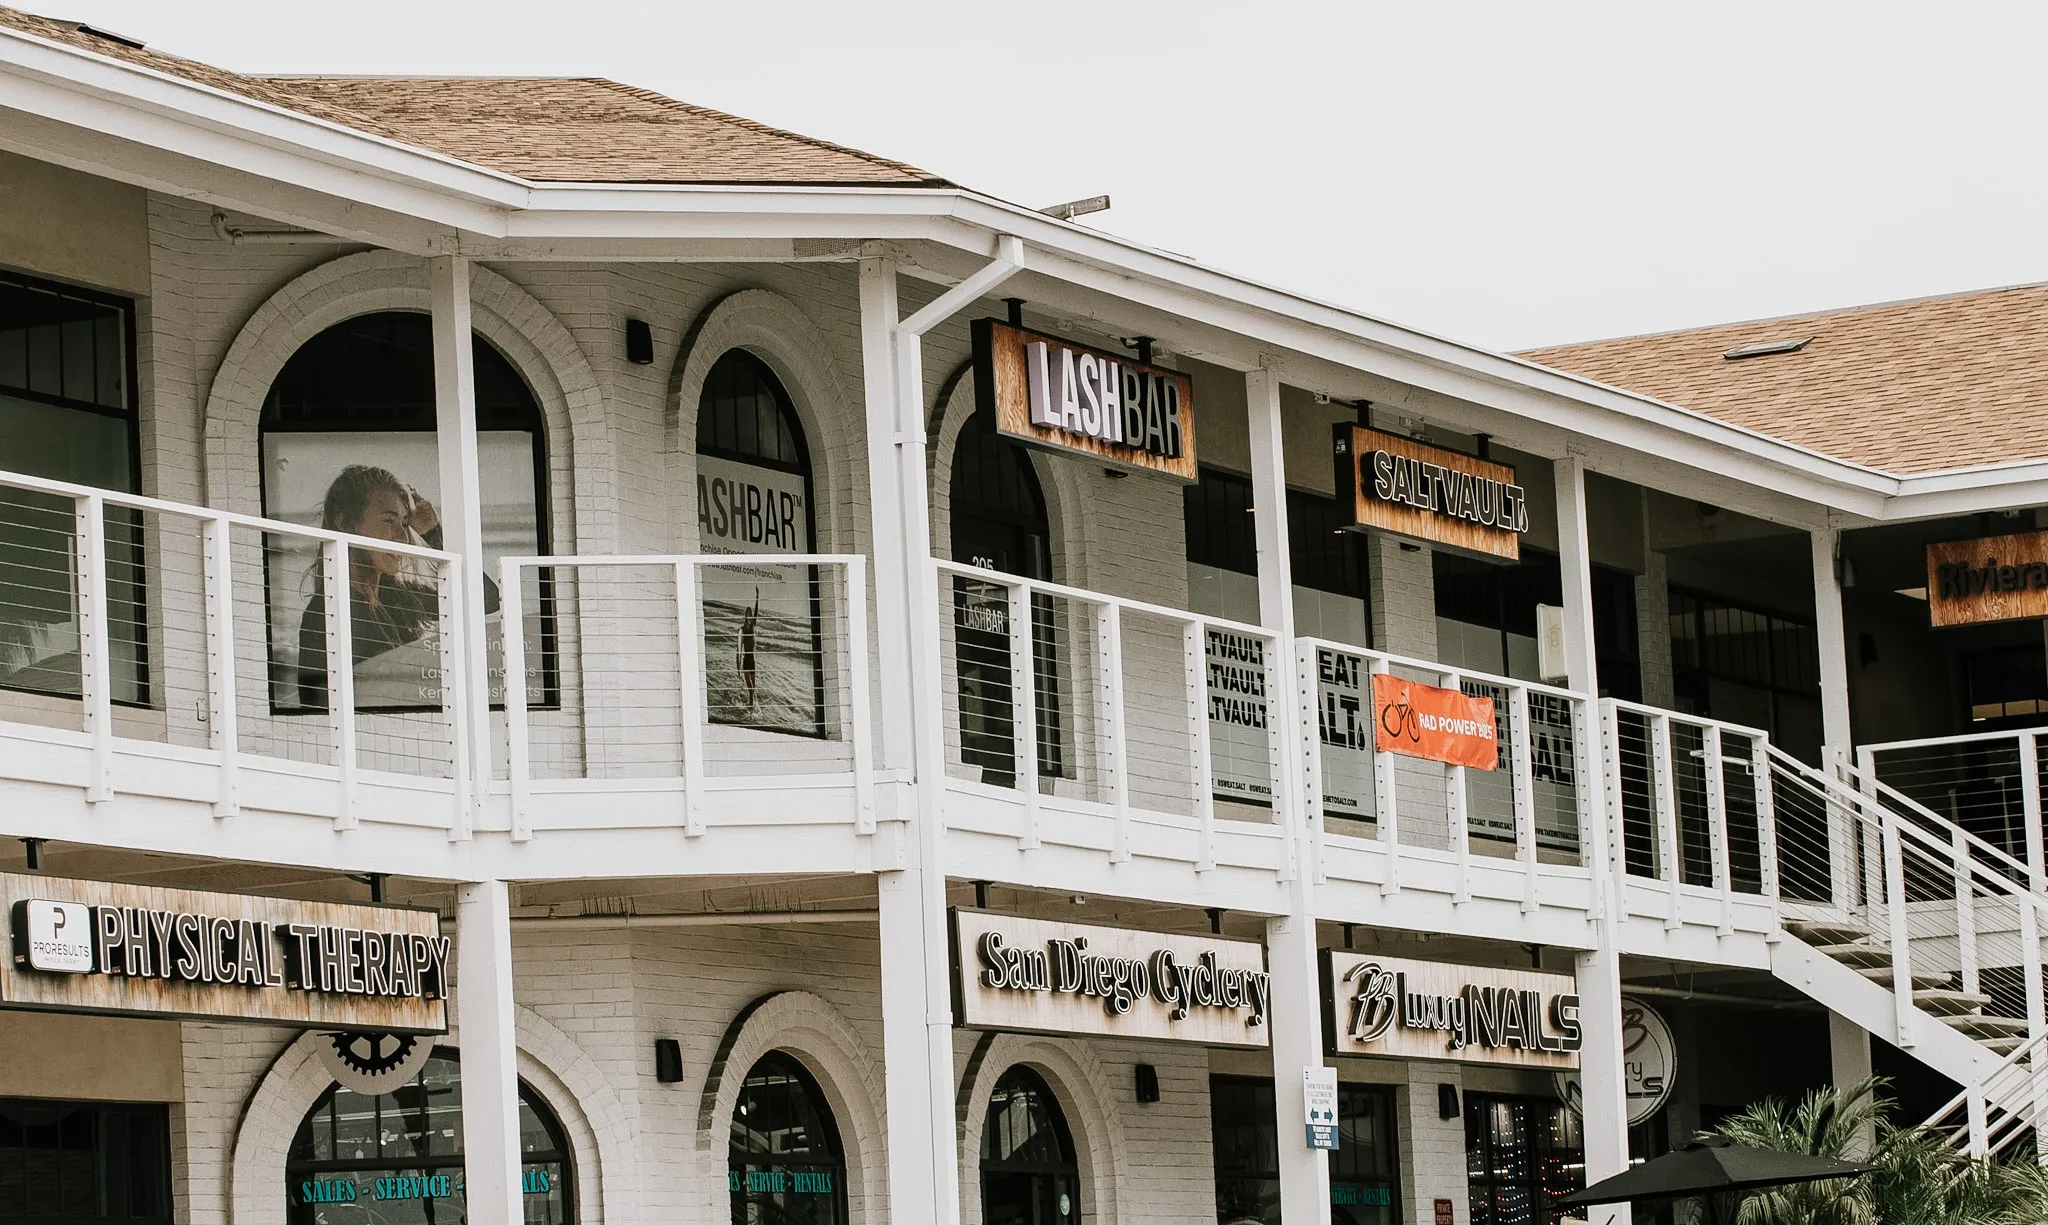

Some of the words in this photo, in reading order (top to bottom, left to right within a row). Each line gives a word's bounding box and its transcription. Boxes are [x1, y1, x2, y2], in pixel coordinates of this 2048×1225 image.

[1032, 341, 1183, 459] LASHBAR
[1373, 449, 1526, 533] SALTVAULT
[1419, 713, 1437, 731] RAD
[1439, 716, 1477, 737] POWER
[33, 941, 89, 957] PRORESULTS
[97, 905, 283, 987] PHYSICAL
[289, 923, 450, 999] THERAPY
[985, 930, 1051, 992] San
[1055, 936, 1150, 1015] Diego
[1153, 949, 1270, 1027] Cyclery
[1404, 973, 1466, 1050] Luxury
[1469, 984, 1583, 1053] NAILS
[303, 1179, 356, 1203] SALES
[375, 1175, 450, 1200] SERVICE
[749, 1171, 785, 1193] SERVICE
[793, 1173, 832, 1193] RENTALS
